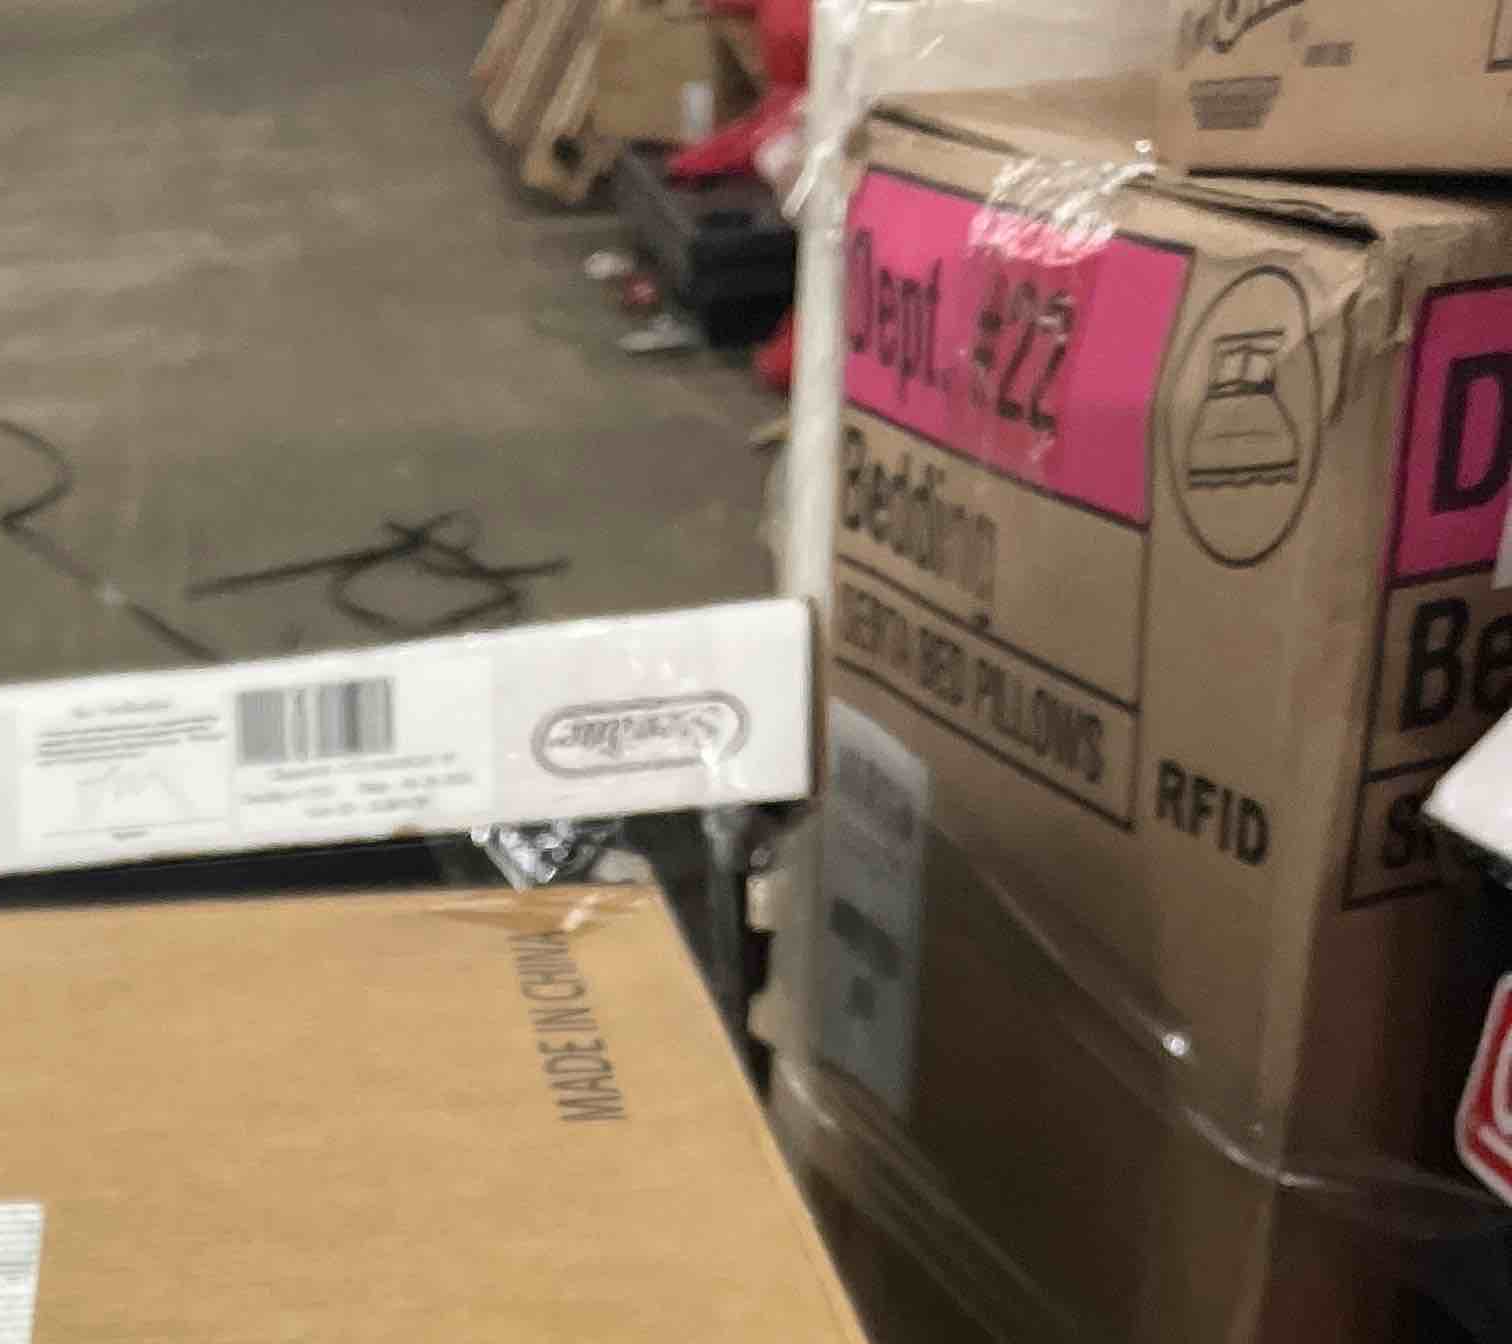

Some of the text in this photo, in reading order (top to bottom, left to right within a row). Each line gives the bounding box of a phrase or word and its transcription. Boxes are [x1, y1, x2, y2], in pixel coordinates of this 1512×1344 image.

[1156, 758, 1271, 867] RFID
[528, 1006, 600, 1034] IN
[548, 1038, 628, 1122] MADE
